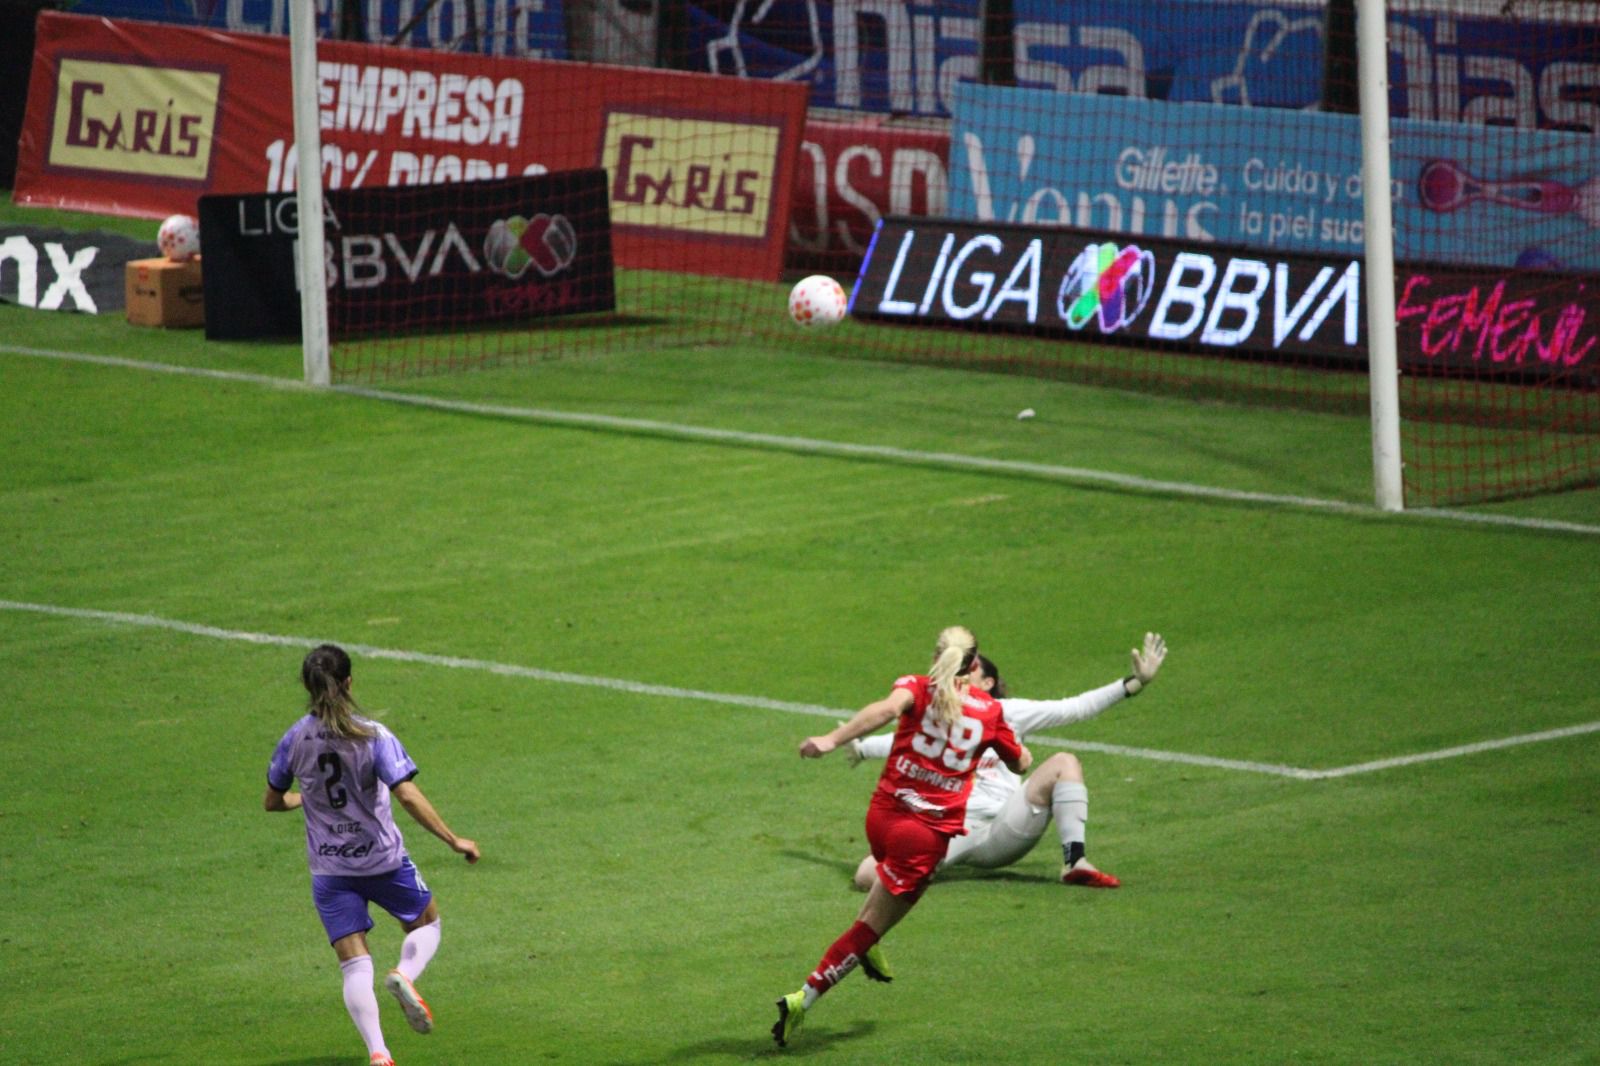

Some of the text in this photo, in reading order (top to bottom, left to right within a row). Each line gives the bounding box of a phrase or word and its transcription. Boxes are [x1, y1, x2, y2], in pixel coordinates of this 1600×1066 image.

[316, 61, 525, 148] EMPRESA
[1114, 146, 1220, 196] Gillette
[1242, 157, 1318, 194] Cuida
[1323, 173, 1339, 203] y
[1240, 202, 1263, 235] la
[1268, 206, 1315, 246] piel
[878, 229, 1042, 324] LIGA
[1148, 252, 1360, 348] BBVA
[317, 752, 348, 810] 2
